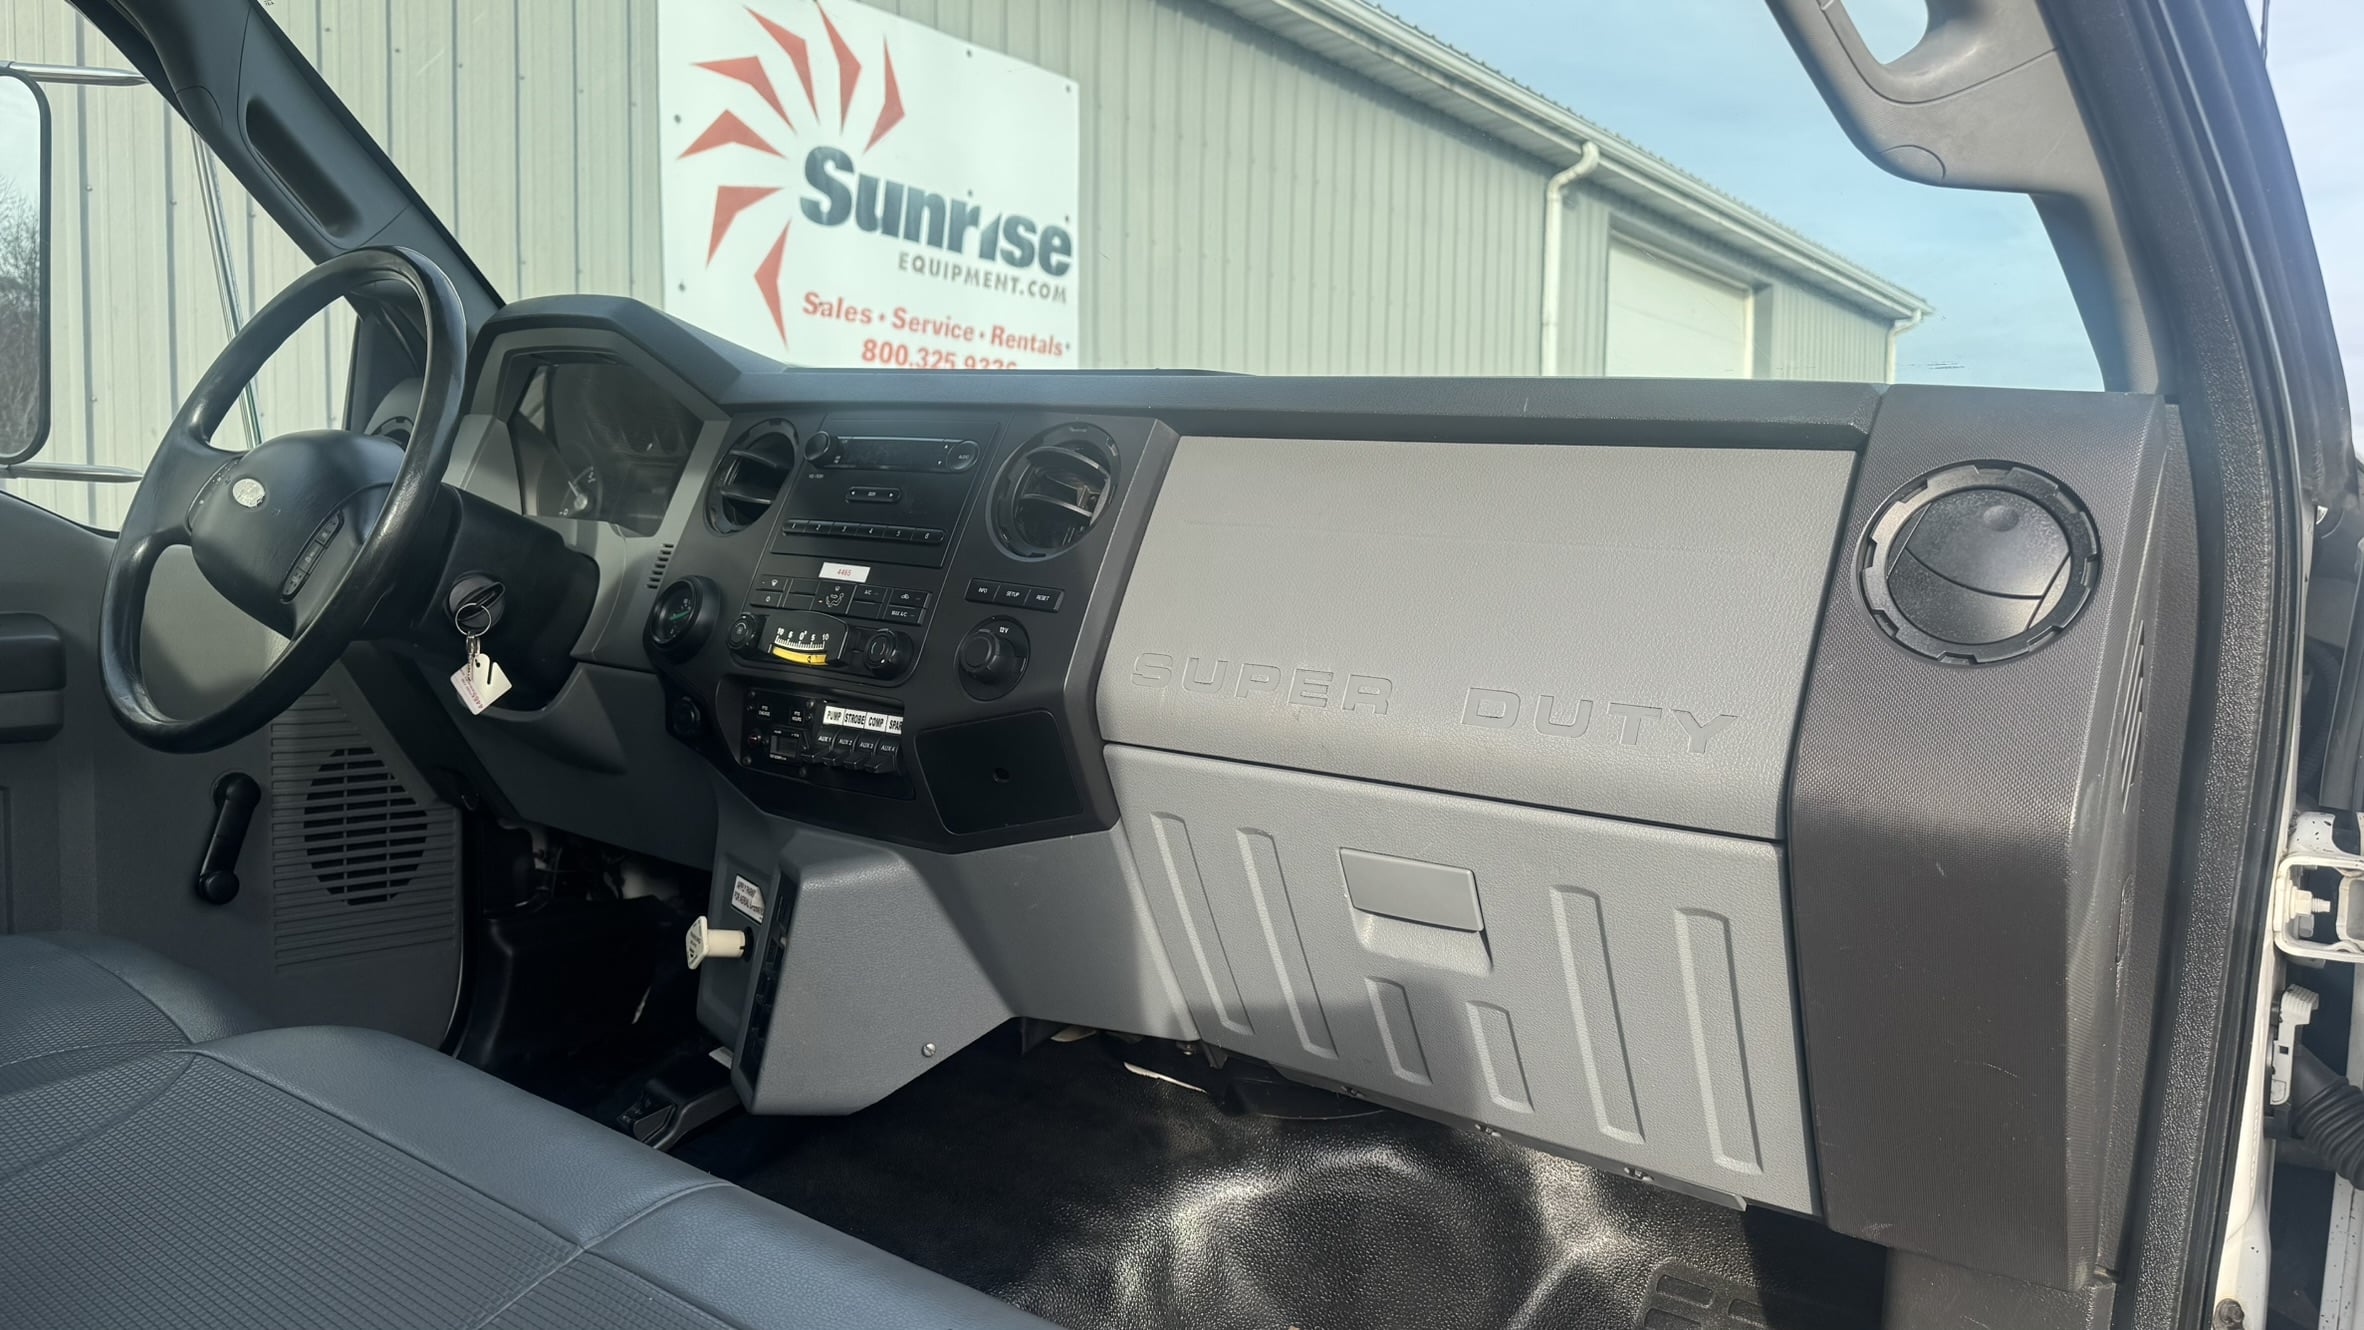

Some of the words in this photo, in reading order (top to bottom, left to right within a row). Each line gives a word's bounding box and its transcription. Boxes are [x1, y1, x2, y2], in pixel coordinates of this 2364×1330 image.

[800, 145, 1073, 277] Sunrise
[899, 252, 1067, 304] EQUIPMENT.COM
[802, 291, 872, 325] Sales
[891, 307, 975, 342] Service
[991, 325, 1063, 357] Rentals
[777, 627, 785, 636] 10
[822, 633, 829, 641] 10
[827, 710, 842, 721] PUMP
[845, 713, 866, 725] STROBE
[1131, 651, 1394, 716] SUPER
[1461, 687, 1740, 754] DUTY
[868, 716, 884, 728] COMP
